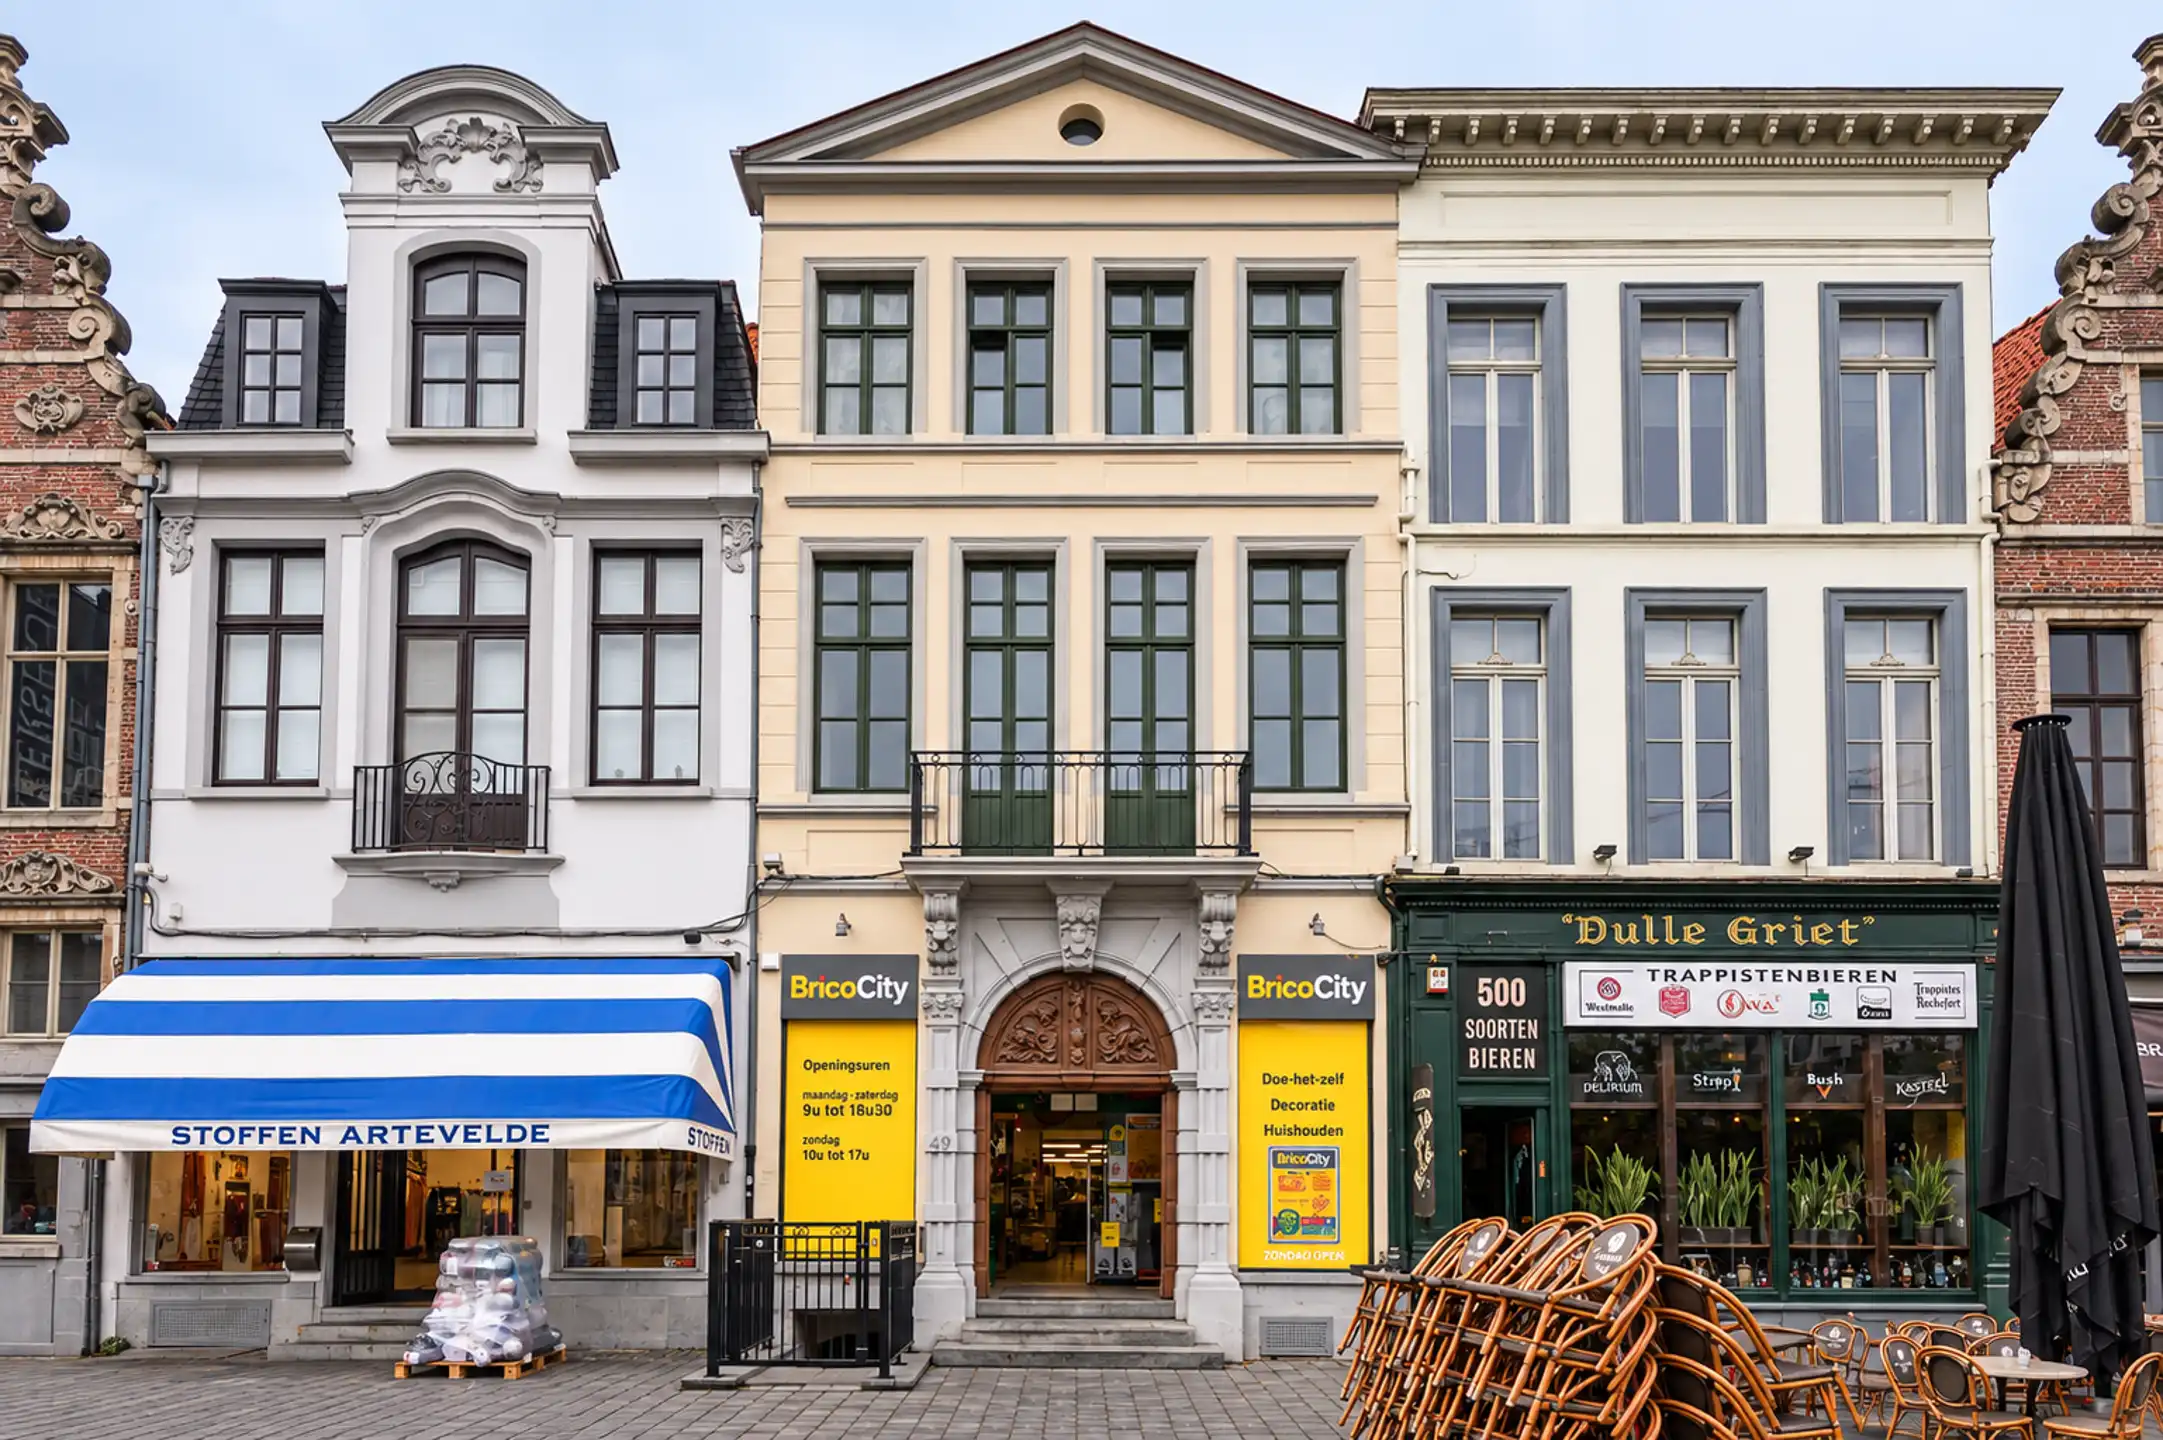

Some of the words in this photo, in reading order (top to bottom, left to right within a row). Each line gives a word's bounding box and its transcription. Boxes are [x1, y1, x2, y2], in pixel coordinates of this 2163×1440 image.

[1647, 968, 1898, 984] TRAPPISTENBIEREN
[790, 974, 909, 1005] BricoCity
[1247, 974, 1367, 1005] BricoCity
[1477, 977, 1527, 1008] 500
[1465, 1018, 1538, 1039] SOORTEN
[1469, 1047, 1536, 1069] BIEREN
[803, 1059, 890, 1073] Openingsuren
[1262, 1072, 1344, 1086] Doe-het-zelf
[1807, 1073, 1843, 1085] Bush
[1583, 1082, 1643, 1094] DELIRIUM
[802, 1089, 848, 1103] maandag
[854, 1089, 899, 1103] zaterdag
[802, 1104, 821, 1117] 9u
[825, 1104, 845, 1117] tot
[849, 1104, 892, 1117] 18u30
[1271, 1098, 1336, 1112] Decoratie
[171, 1126, 321, 1145] STOFFEN
[339, 1124, 550, 1144] ARTEVELDE
[1263, 1123, 1345, 1137] Huishouden
[687, 1126, 730, 1155] STOFFEN
[802, 1134, 840, 1148] zondag
[929, 1135, 951, 1151] 49
[803, 1150, 824, 1161] 10u
[827, 1149, 844, 1161] tot
[848, 1149, 870, 1161] 17u
